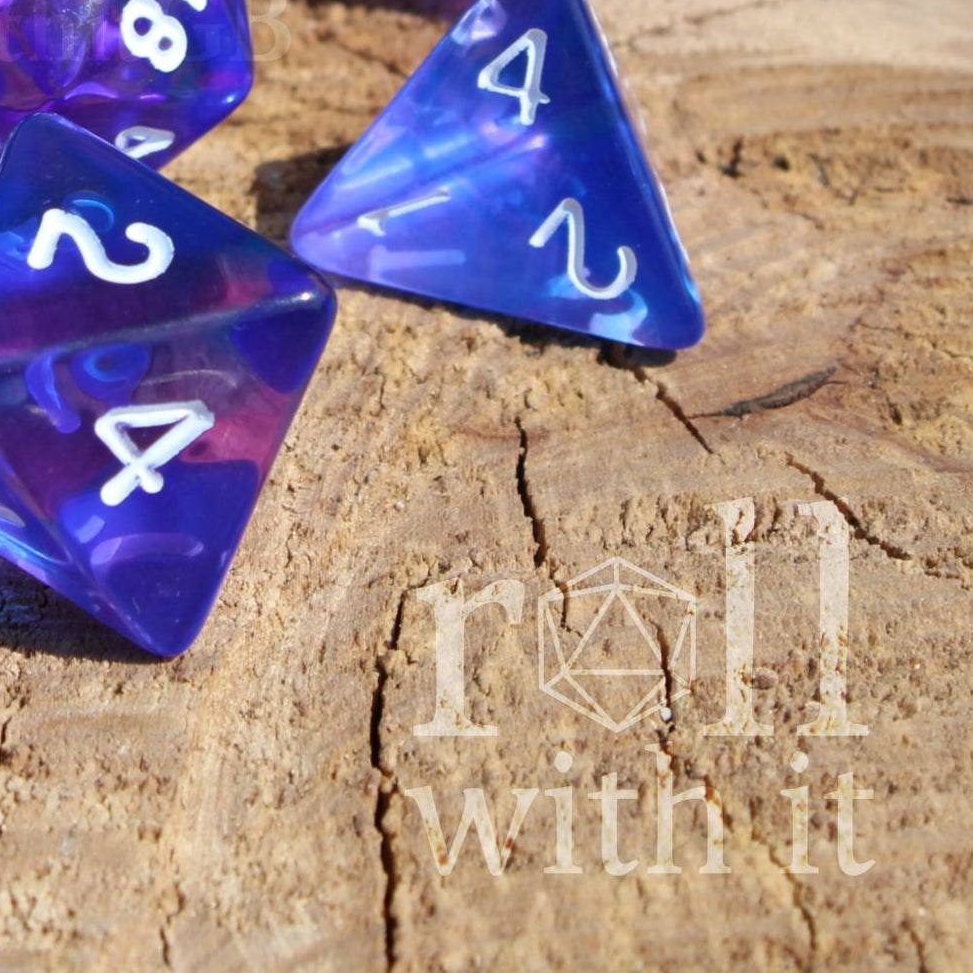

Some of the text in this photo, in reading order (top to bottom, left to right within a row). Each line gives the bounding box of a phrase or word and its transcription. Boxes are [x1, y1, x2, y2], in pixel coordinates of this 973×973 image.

[477, 28, 551, 126] 4
[27, 208, 174, 285] 2
[528, 197, 638, 300] 2
[94, 399, 215, 507] 4
